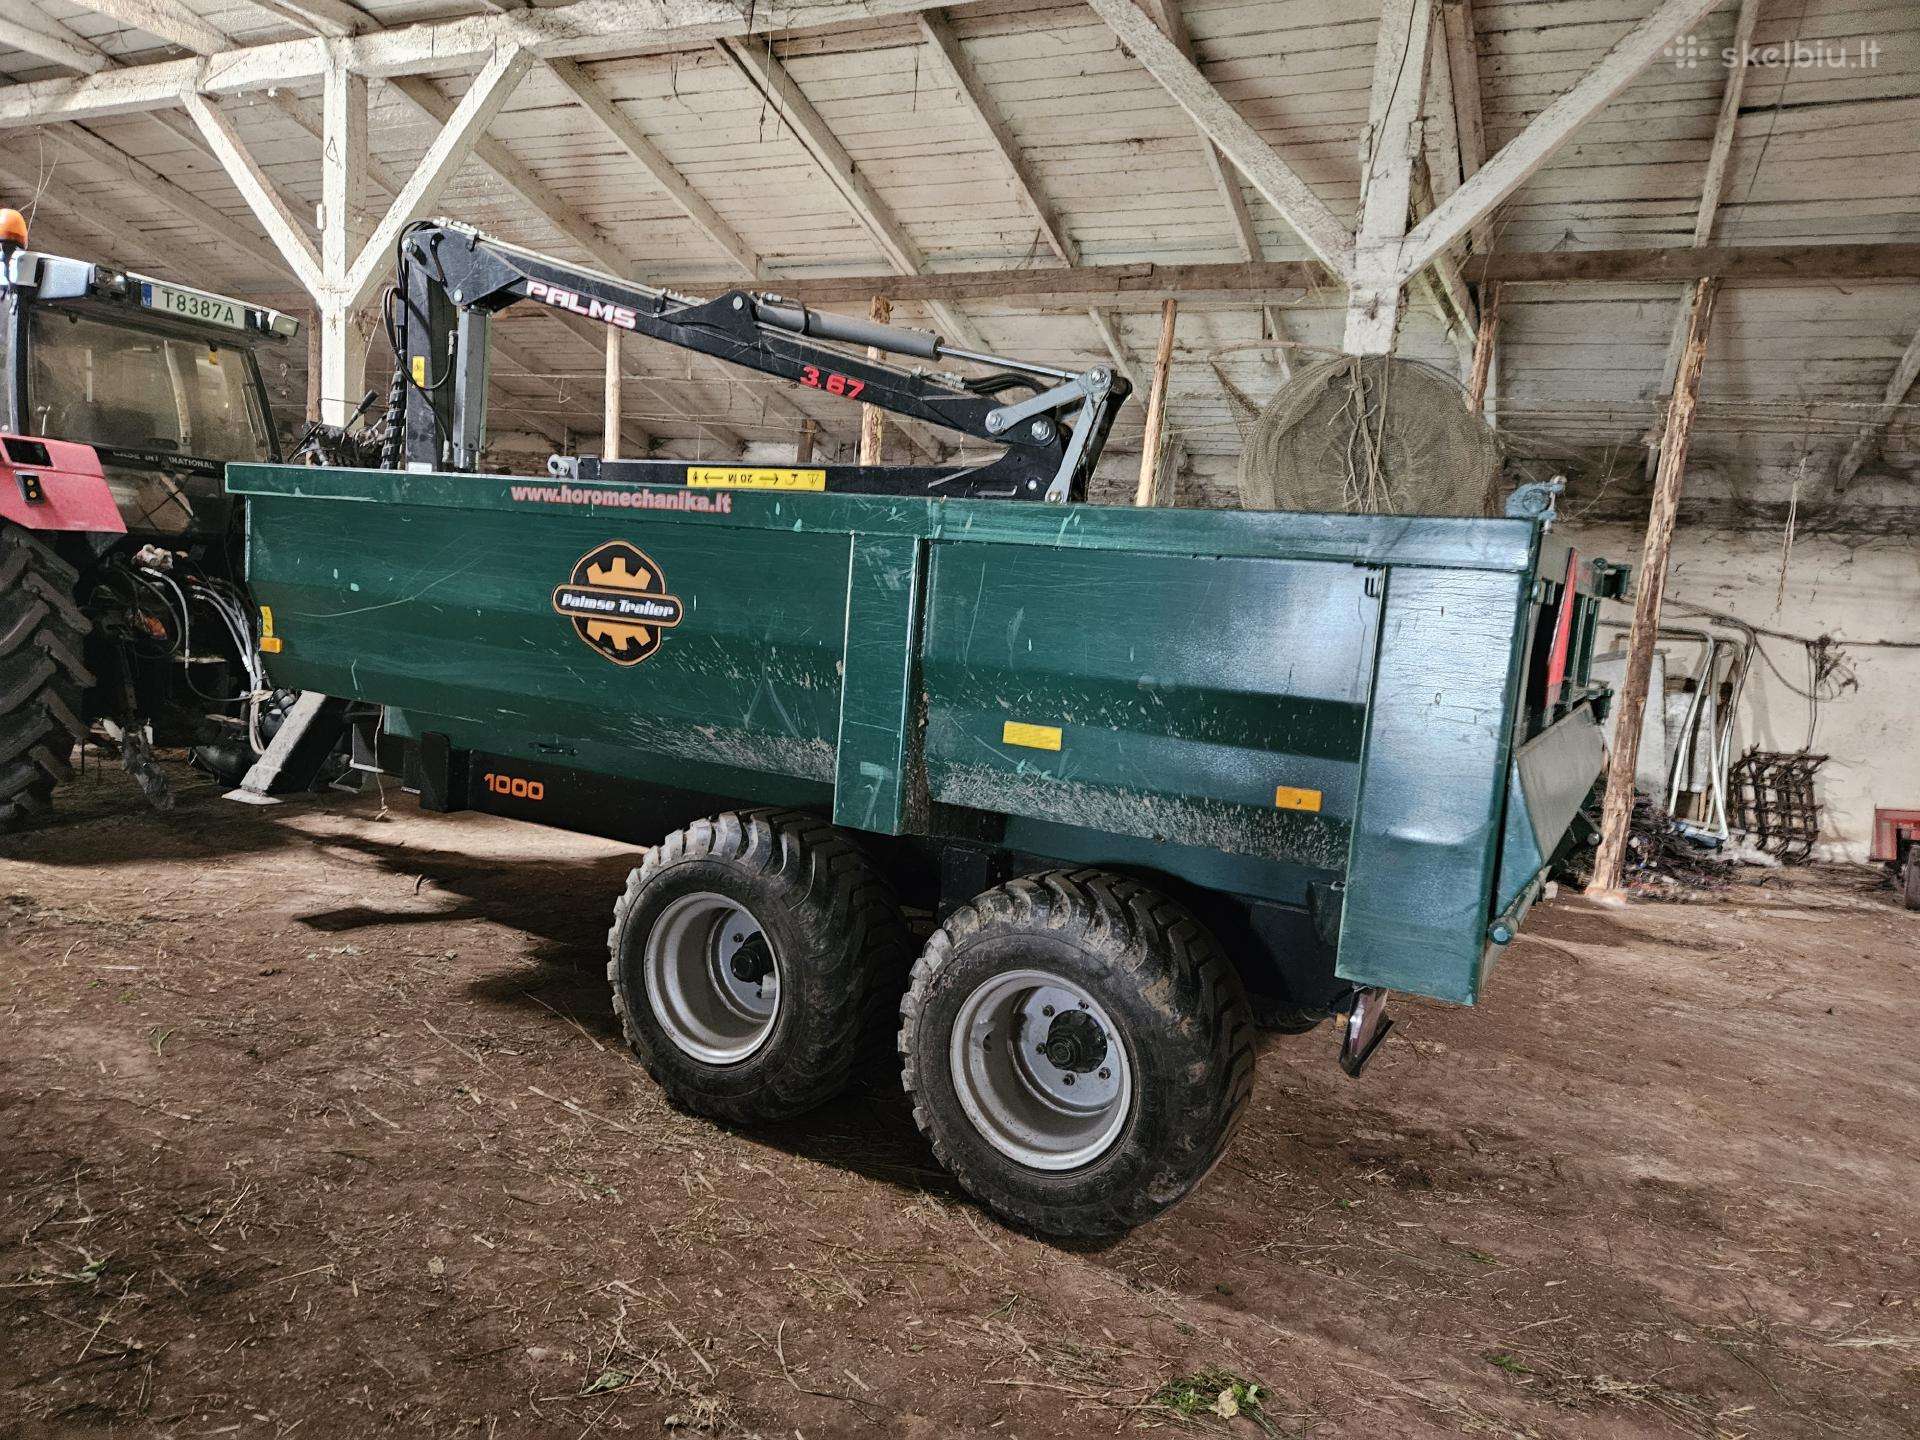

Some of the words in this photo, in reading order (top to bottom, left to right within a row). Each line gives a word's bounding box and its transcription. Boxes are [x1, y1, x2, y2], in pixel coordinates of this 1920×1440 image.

[162, 288, 235, 324] T8387A
[526, 280, 636, 330] PALMS
[800, 364, 865, 400] 3.67
[511, 484, 732, 514] www.horomechanika.lt
[561, 593, 616, 611] Palmse
[618, 599, 674, 617] Trailer
[484, 773, 544, 801] 1000
